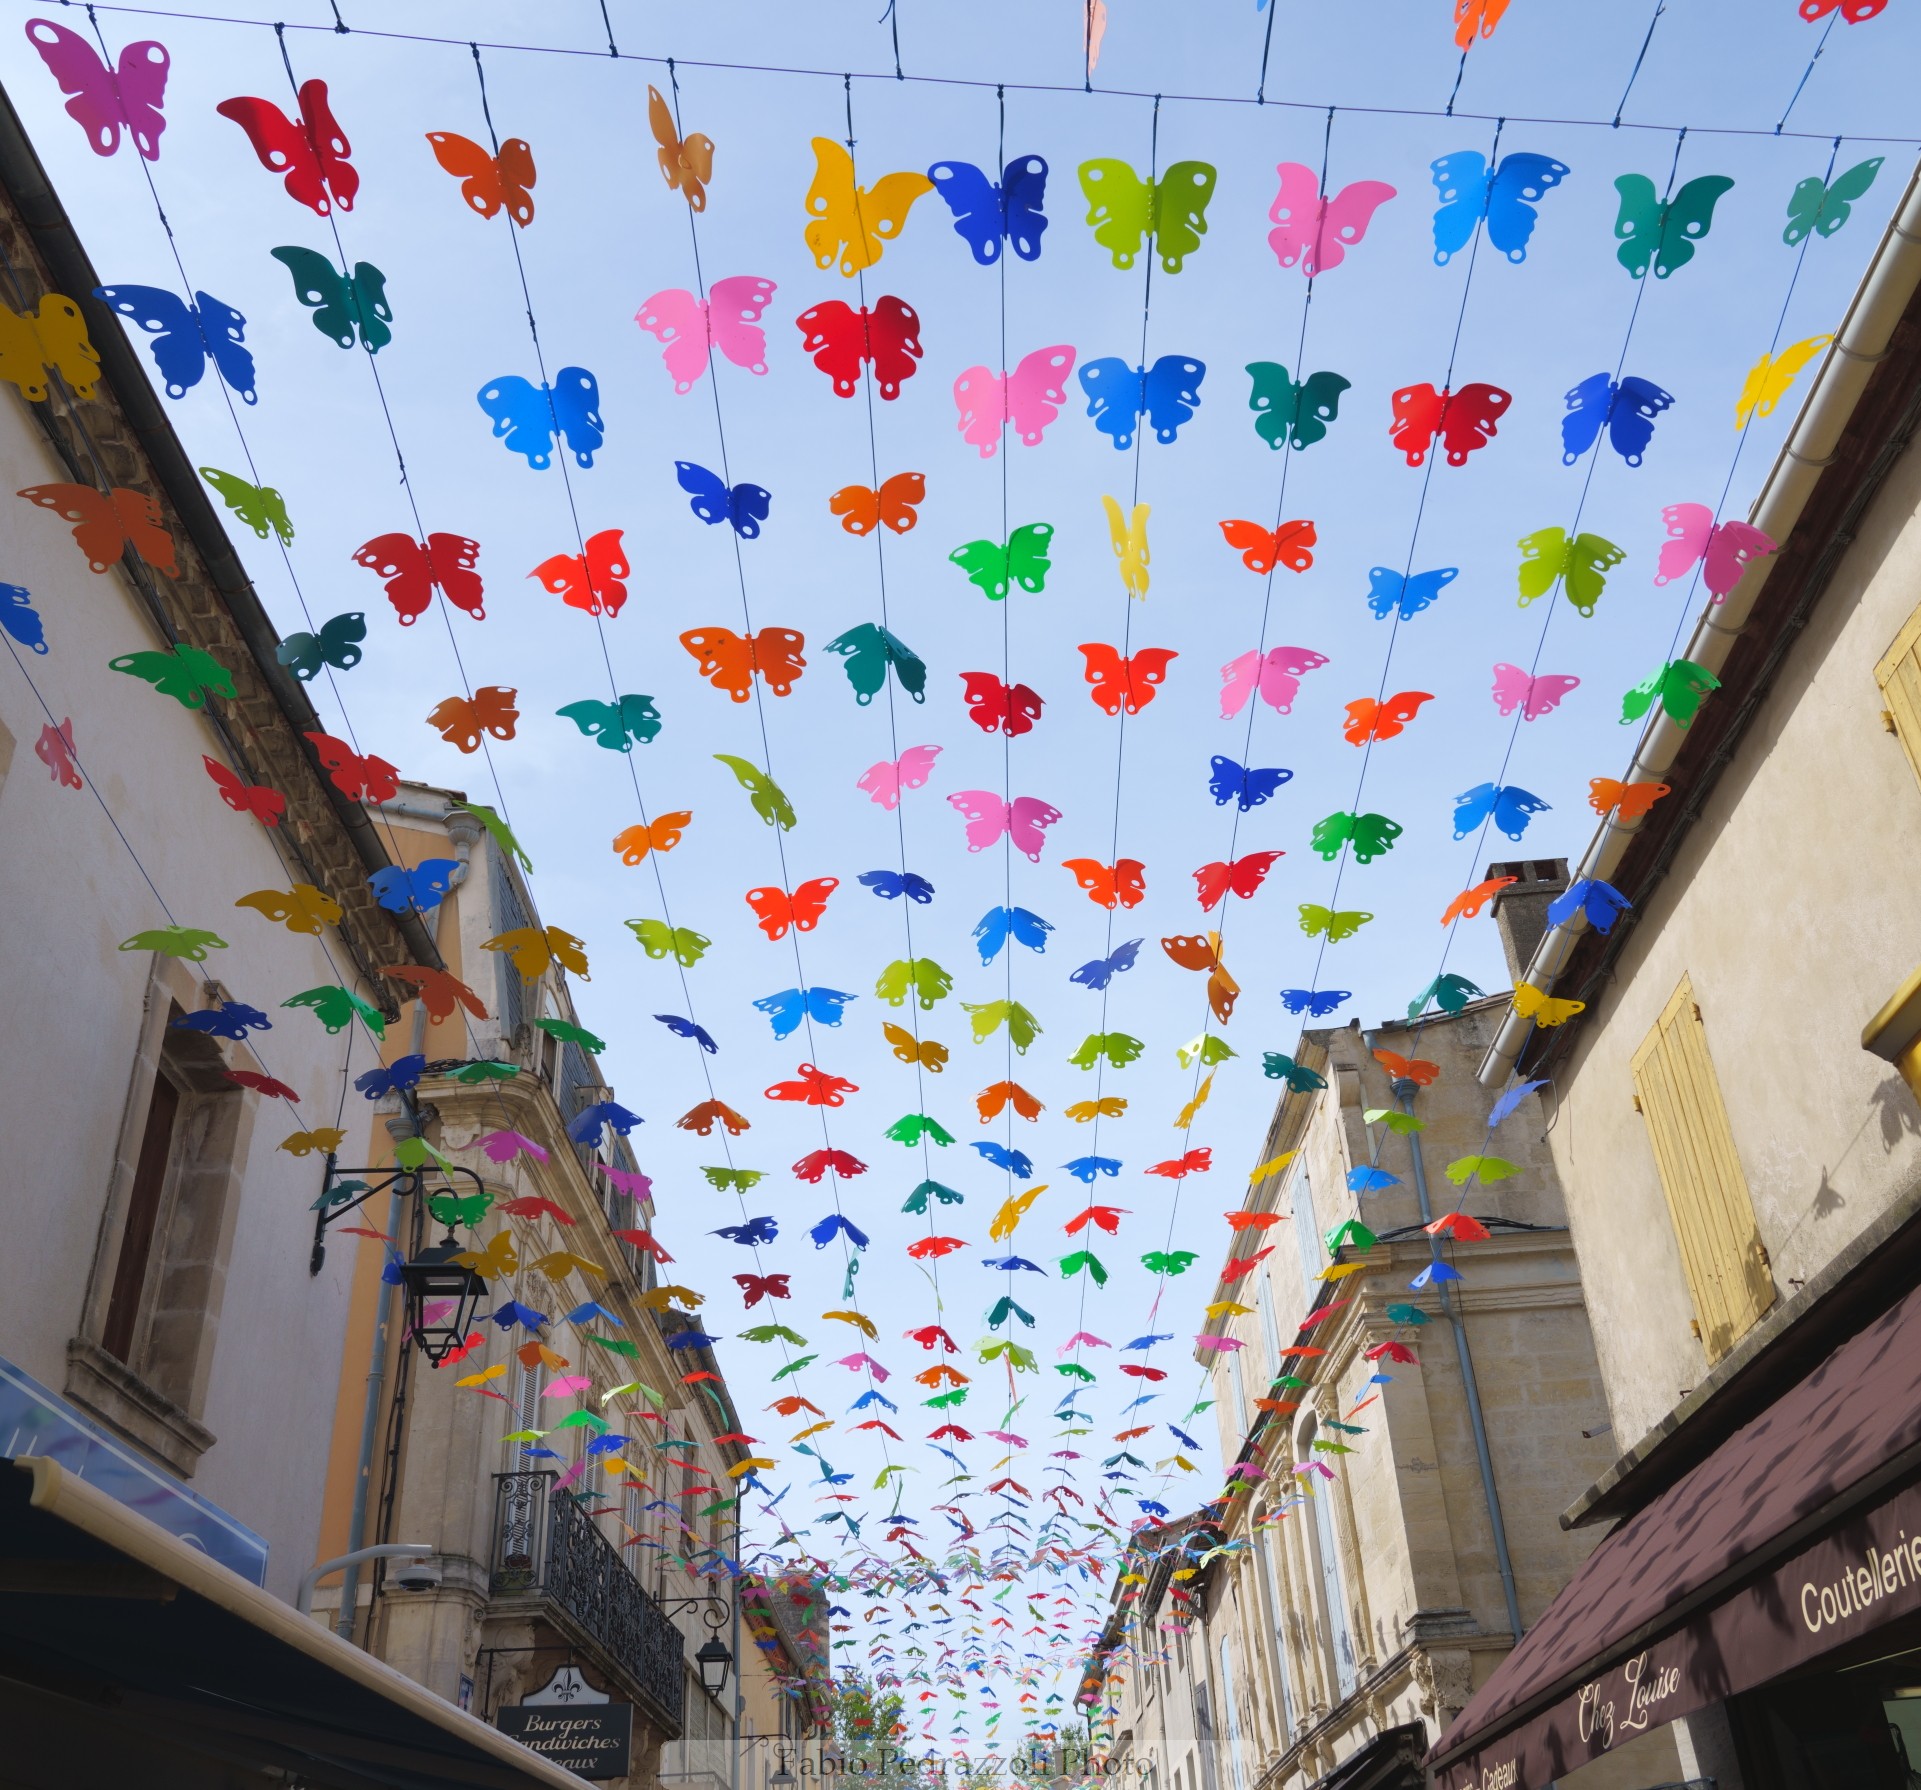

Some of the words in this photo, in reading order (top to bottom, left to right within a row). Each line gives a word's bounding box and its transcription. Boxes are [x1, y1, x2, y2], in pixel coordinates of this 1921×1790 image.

[1801, 1529, 1921, 1633] Coutellerie
[523, 1714, 602, 1740] Burgers
[1577, 1683, 1616, 1749] Chez
[1620, 1650, 1681, 1730] Louise
[1482, 1757, 1519, 1790] Cadeaux
